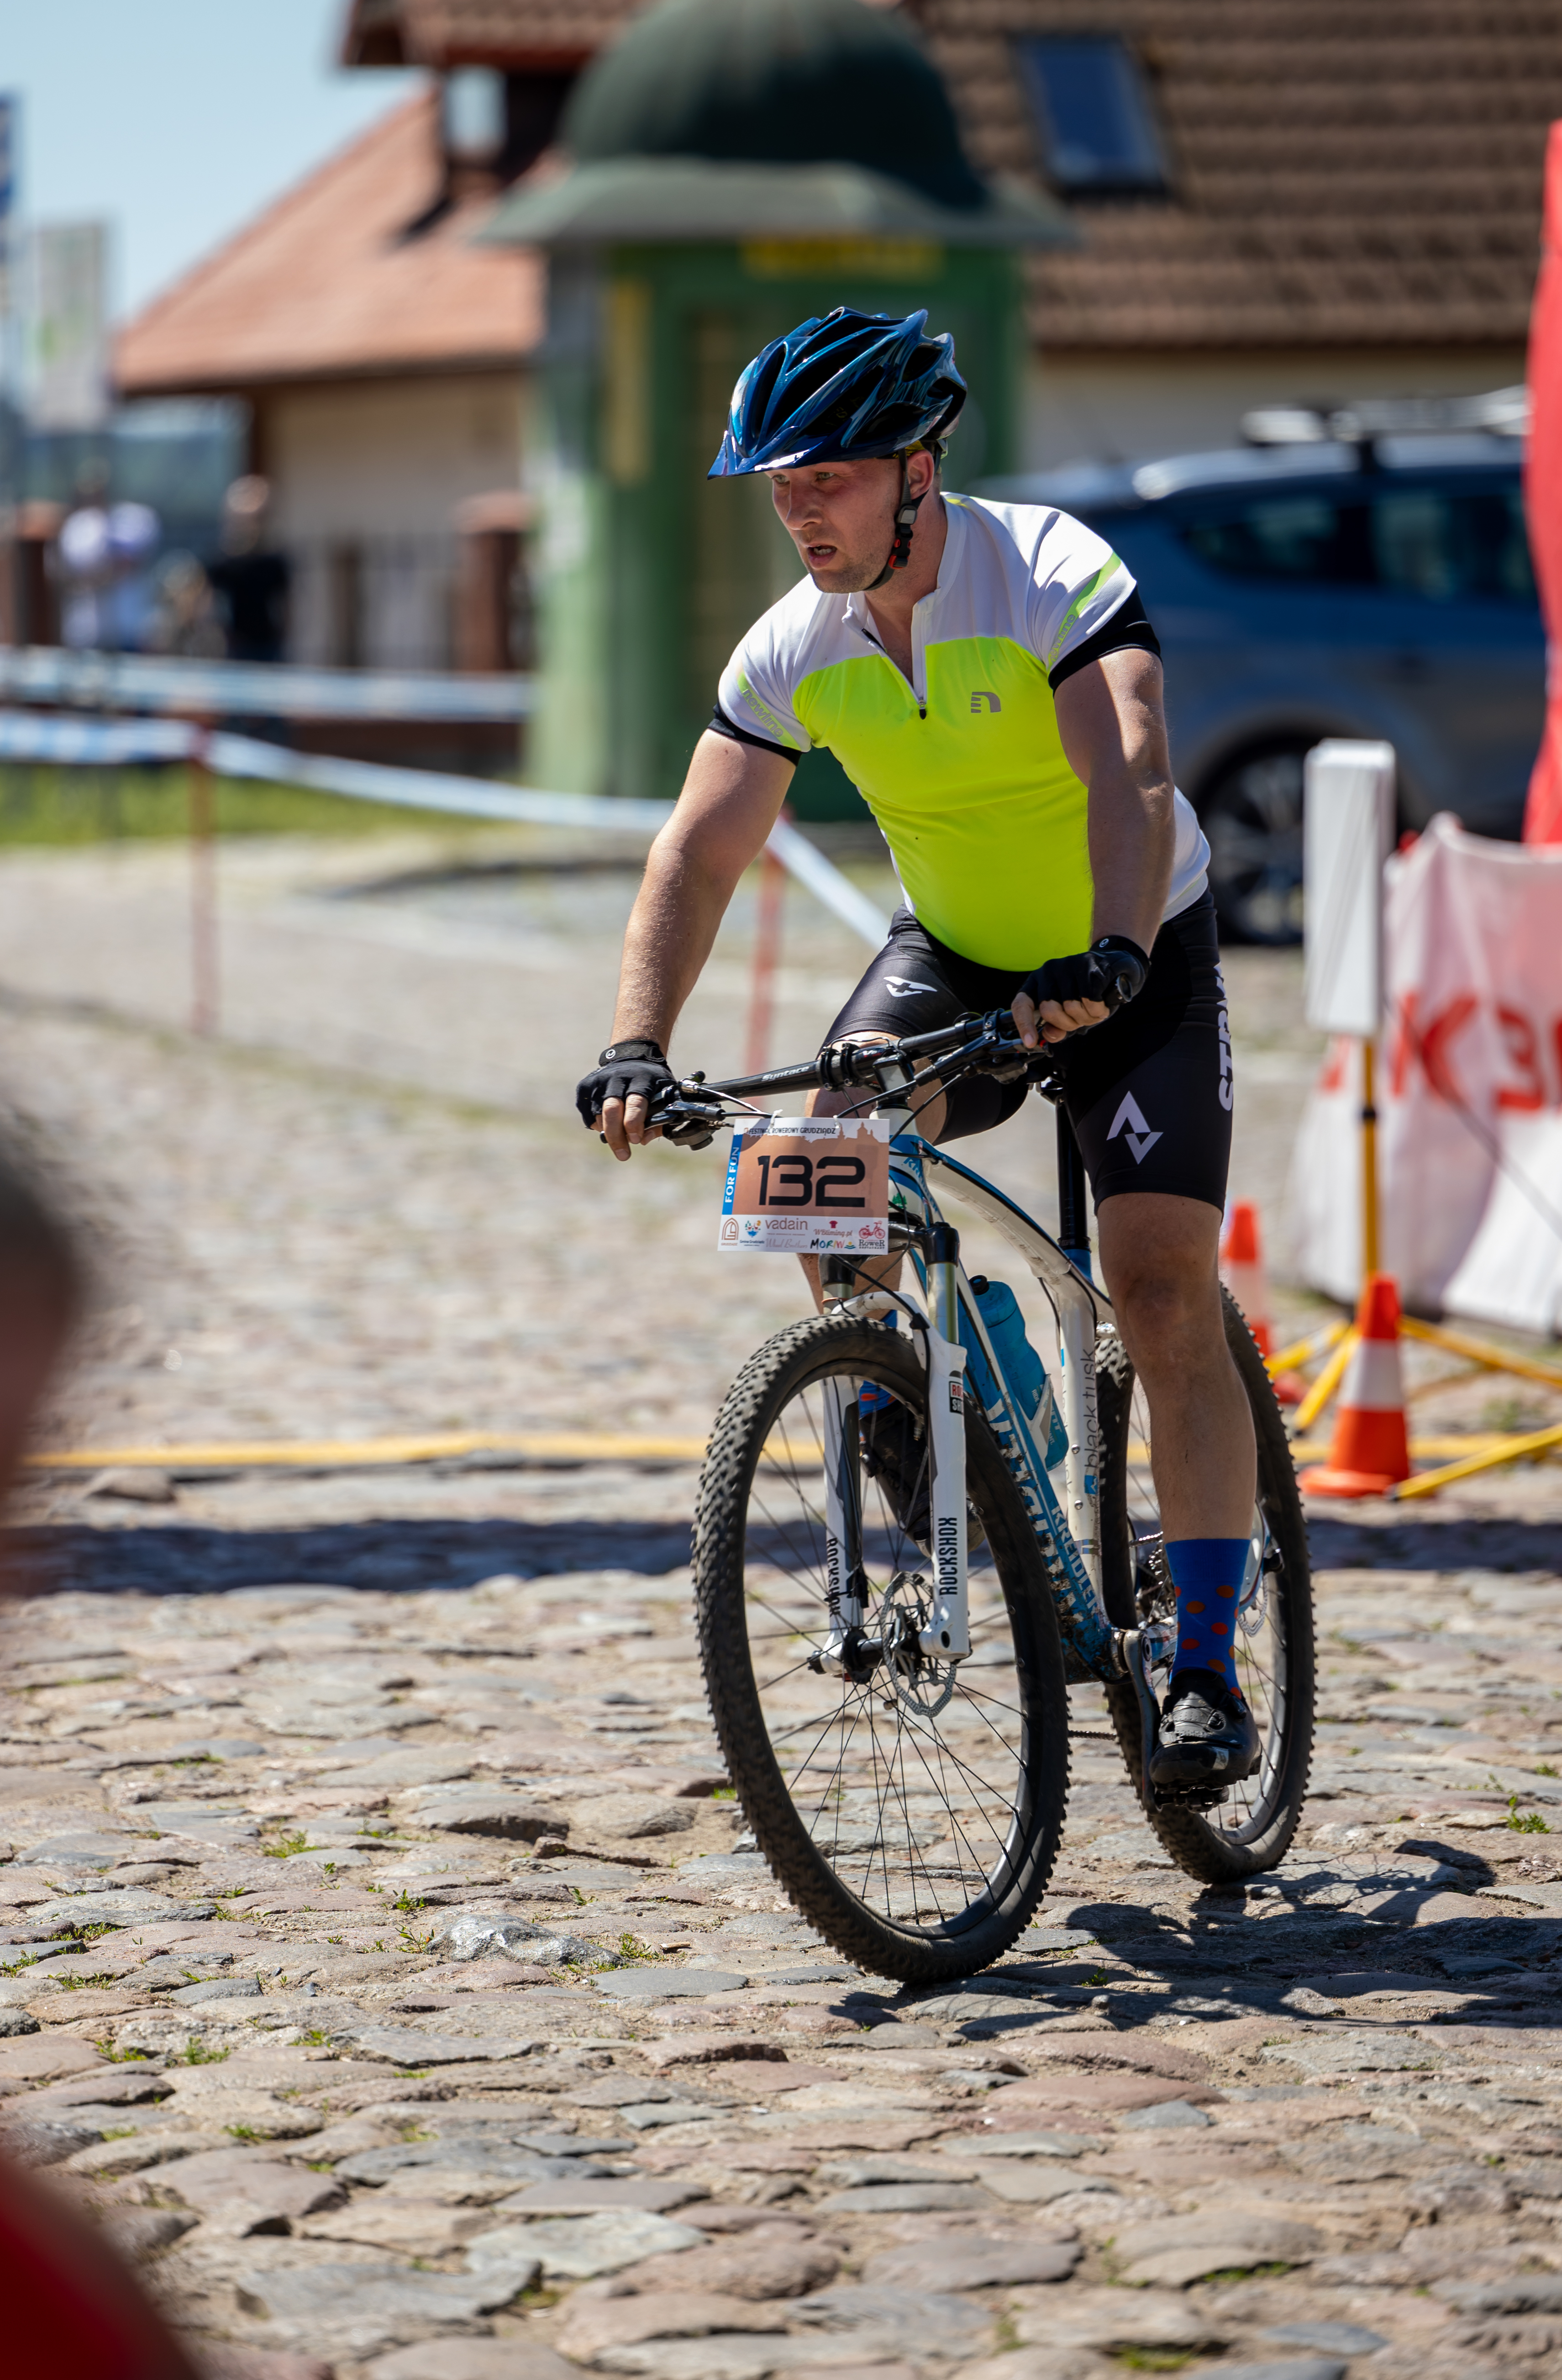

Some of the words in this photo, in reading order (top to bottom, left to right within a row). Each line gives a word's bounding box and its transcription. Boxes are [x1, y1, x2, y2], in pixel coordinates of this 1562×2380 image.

[742, 689, 784, 737] newline
[761, 1066, 810, 1082] Syntace
[800, 1128, 836, 1136] GRUDZIĄDZ
[728, 1147, 740, 1173] FUN
[757, 1155, 866, 1208] 132
[725, 1177, 735, 1203] FOR
[765, 1218, 808, 1230] vadain
[1080, 1349, 1095, 1399] tusk
[1083, 1404, 1098, 1467] black
[938, 1517, 958, 1595] ROCKSHOX
[1051, 1504, 1097, 1615] KREIDLER
